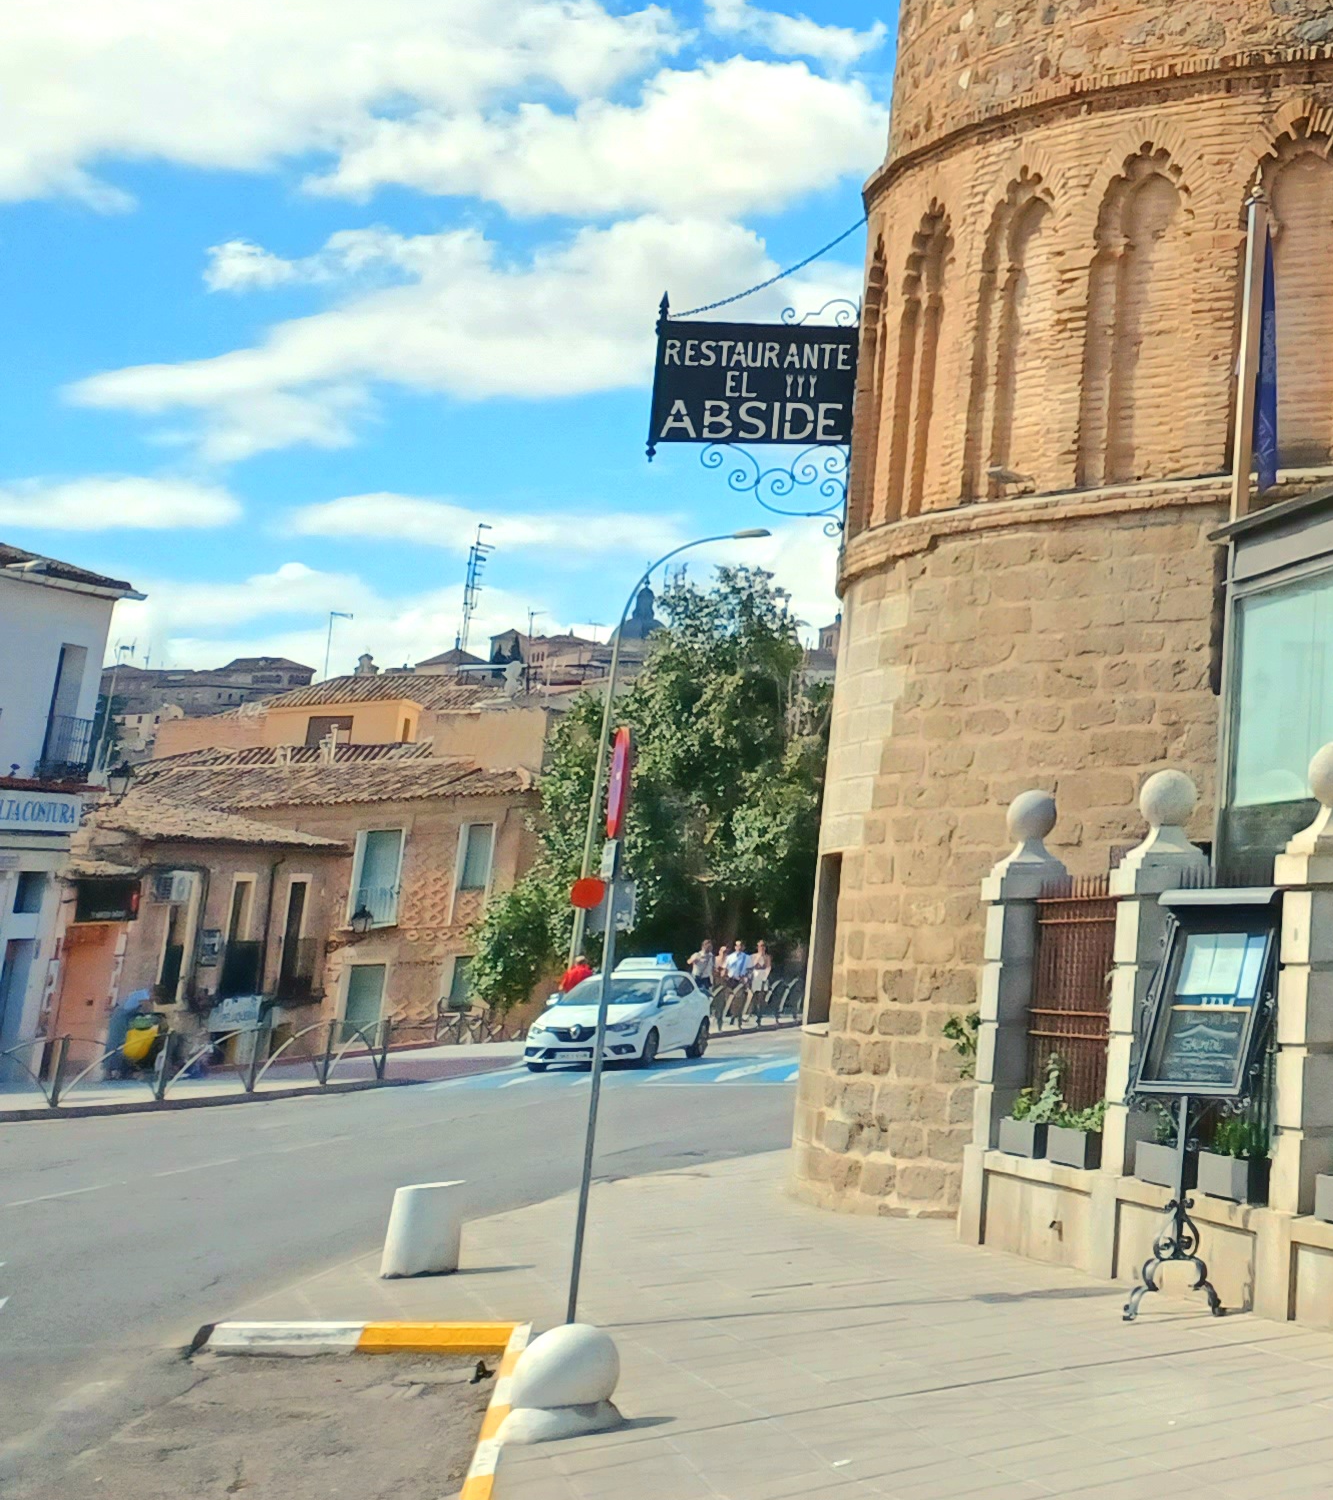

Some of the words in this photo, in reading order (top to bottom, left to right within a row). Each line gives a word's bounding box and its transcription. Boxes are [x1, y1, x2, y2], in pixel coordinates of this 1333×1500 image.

[664, 339, 852, 370] RESTAURANTE
[725, 371, 757, 398] EL
[659, 399, 844, 441] ABSIDE
